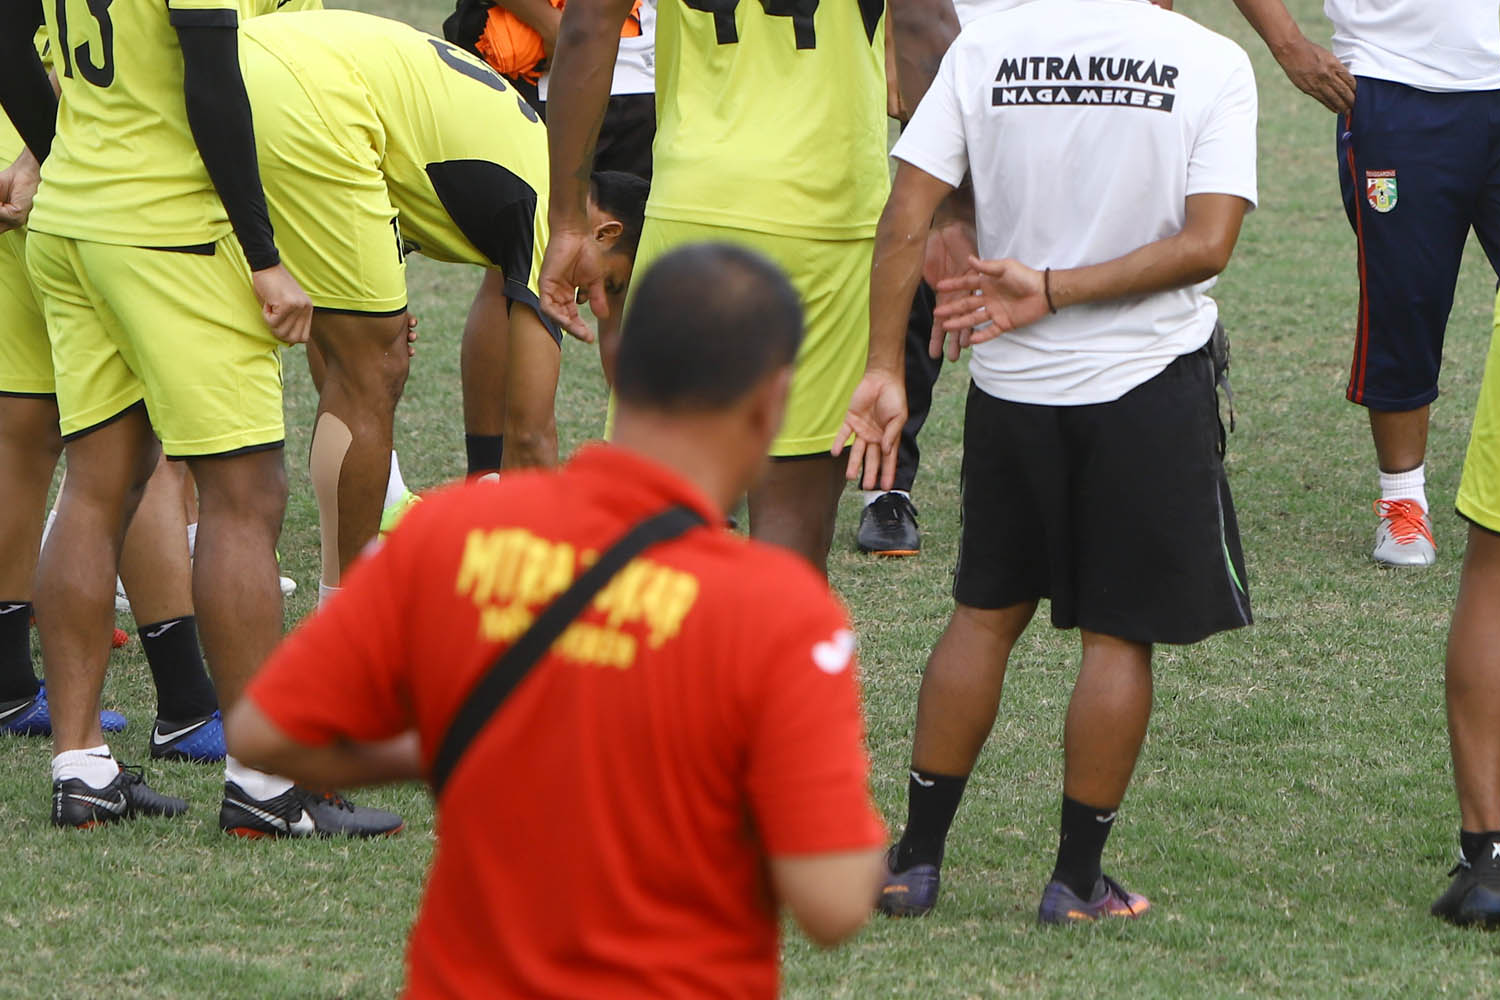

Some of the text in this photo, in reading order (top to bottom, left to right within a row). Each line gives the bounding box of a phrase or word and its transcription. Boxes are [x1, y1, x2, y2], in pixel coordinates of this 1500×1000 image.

[995, 53, 1179, 89] MITRA KUKAR
[1002, 87, 1163, 108] NAGA MEKES
